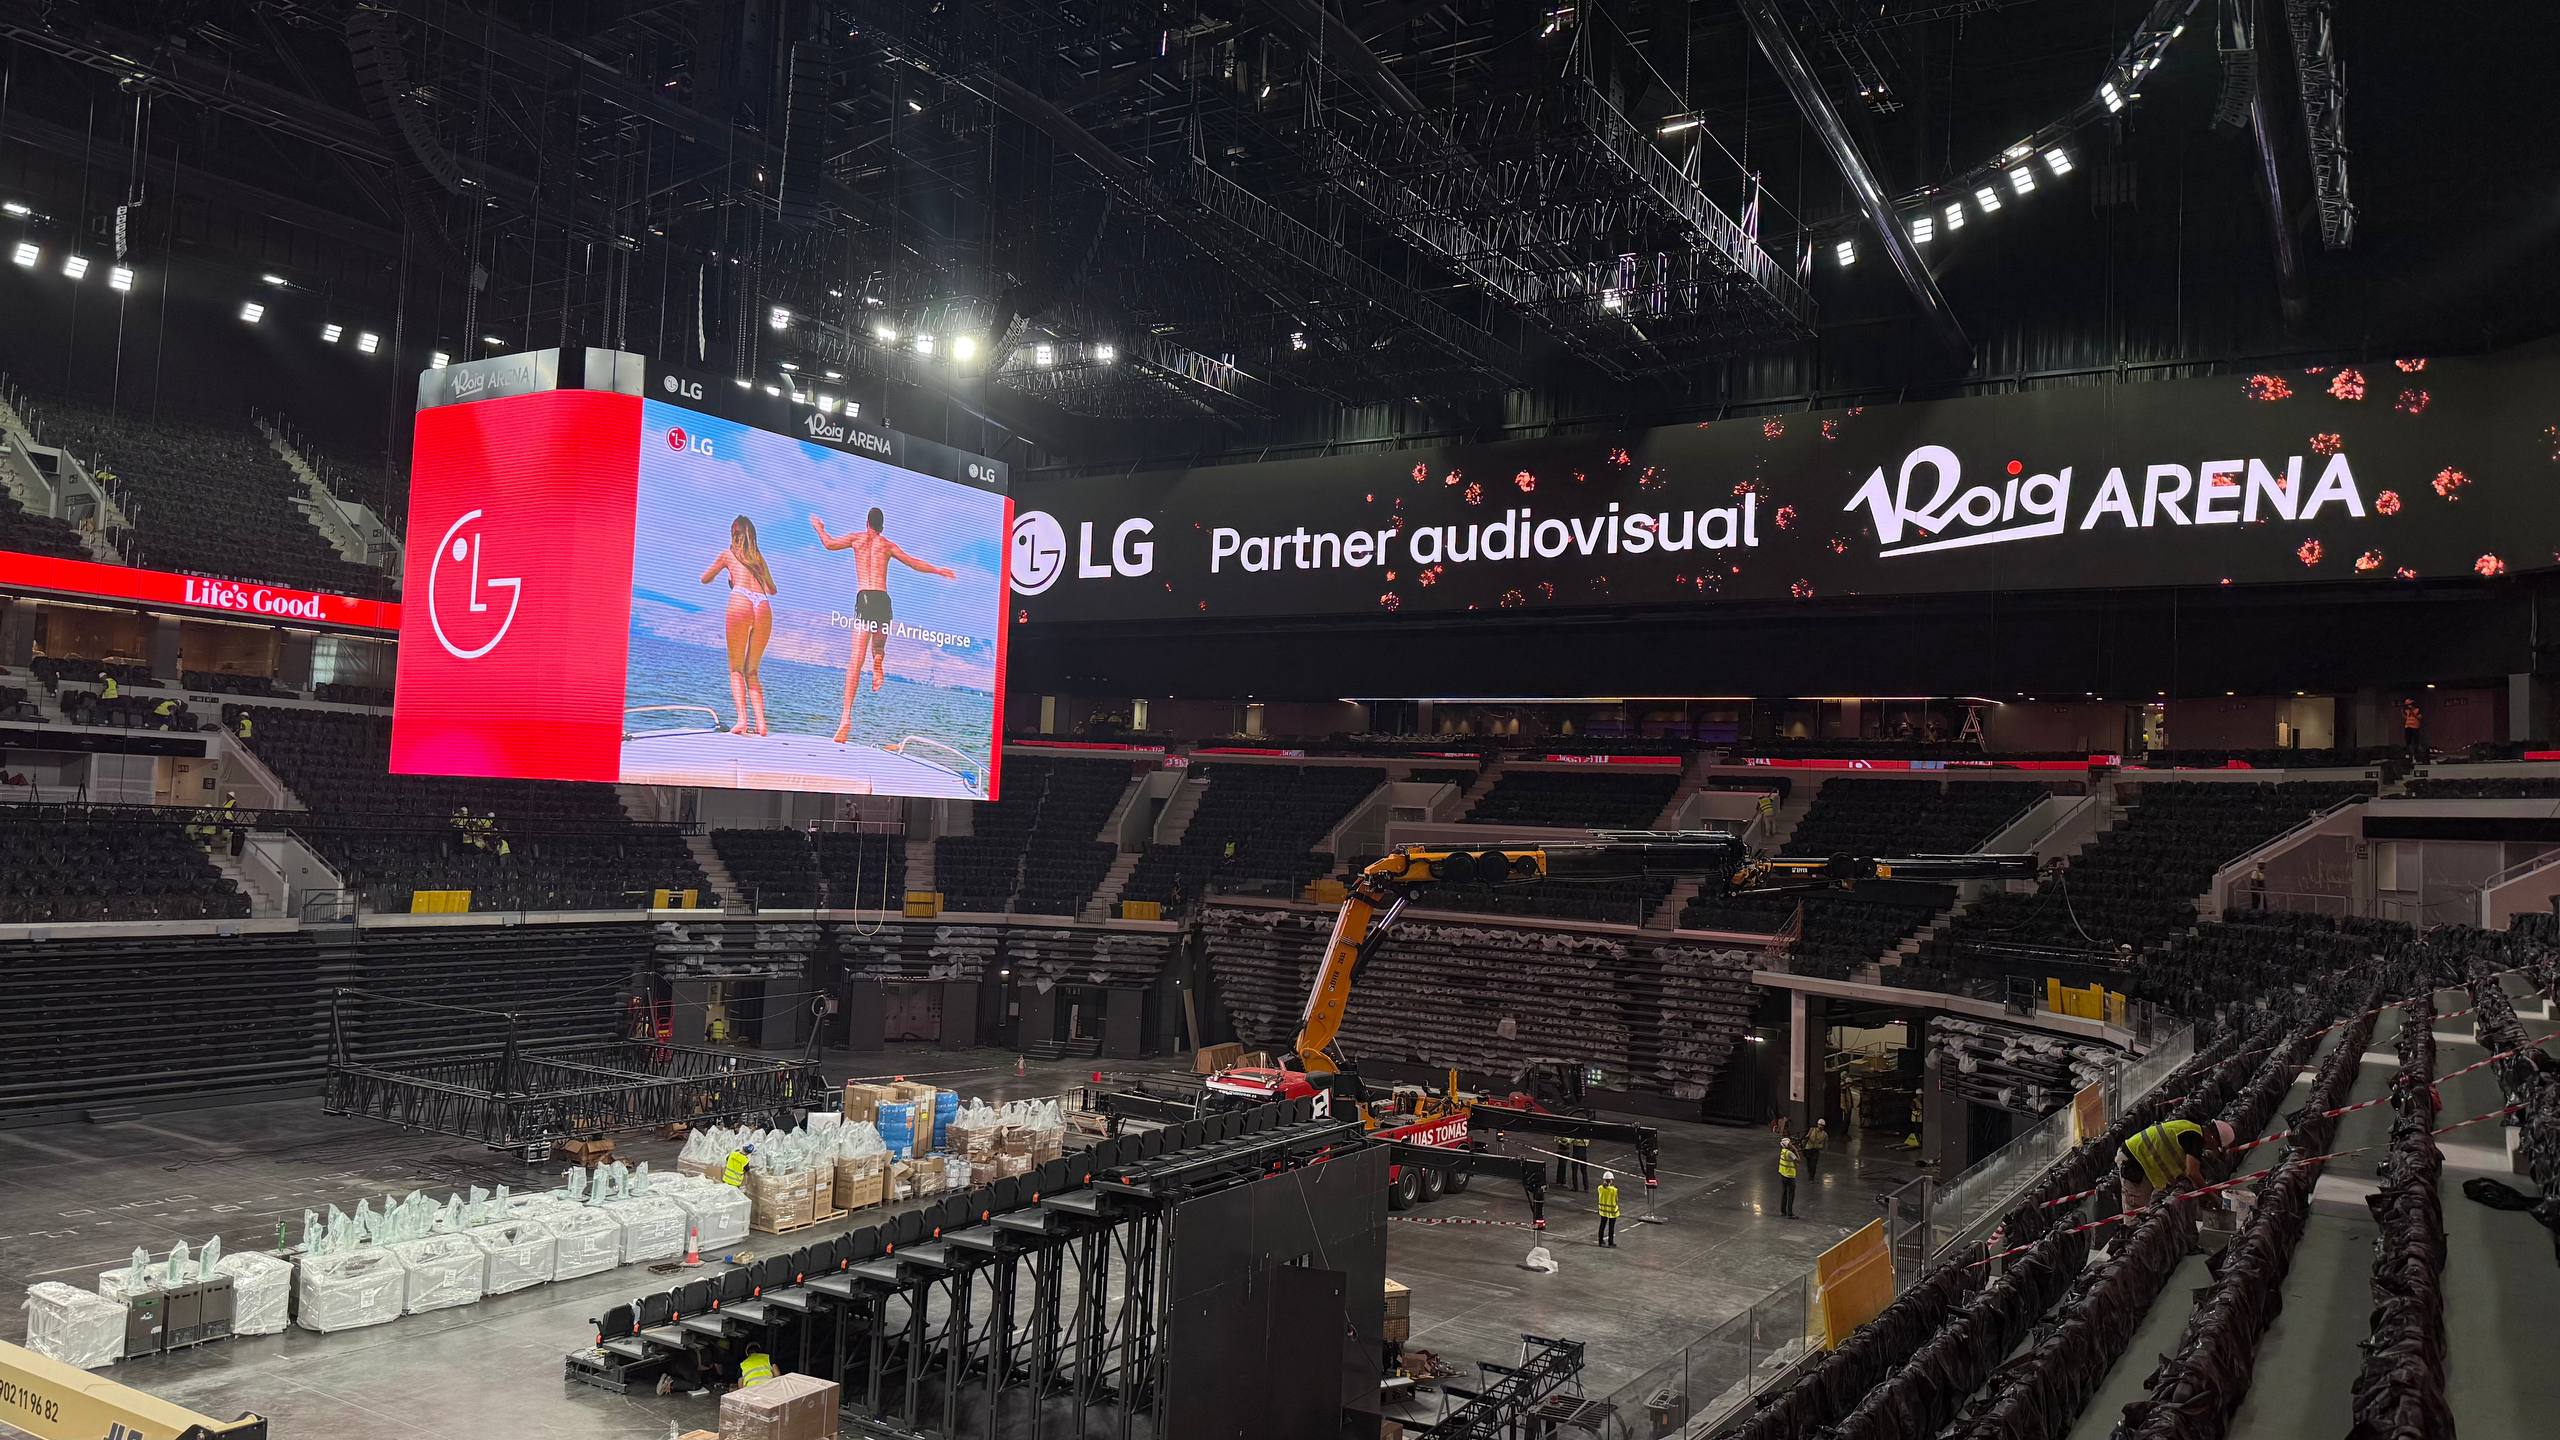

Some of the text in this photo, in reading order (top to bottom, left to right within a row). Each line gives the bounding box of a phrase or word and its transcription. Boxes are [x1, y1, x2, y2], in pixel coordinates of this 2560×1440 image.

[451, 365, 530, 399] Roig ARENA
[680, 378, 703, 400] LG
[690, 434, 714, 456] LG
[804, 413, 892, 456] Roig ARENA
[979, 465, 996, 483] LG
[1843, 445, 2366, 558] Roig ARENA
[1078, 517, 1155, 578] LG
[1211, 492, 1759, 574] Partner audiovisual
[185, 579, 327, 619] Life's Good.
[831, 610, 971, 648] Porque al Arriesgarse
[1436, 1120, 1468, 1143] TOMAS
[19, 1387, 28, 1410] 11
[30, 1392, 42, 1416] 96
[44, 1399, 59, 1423] 82
